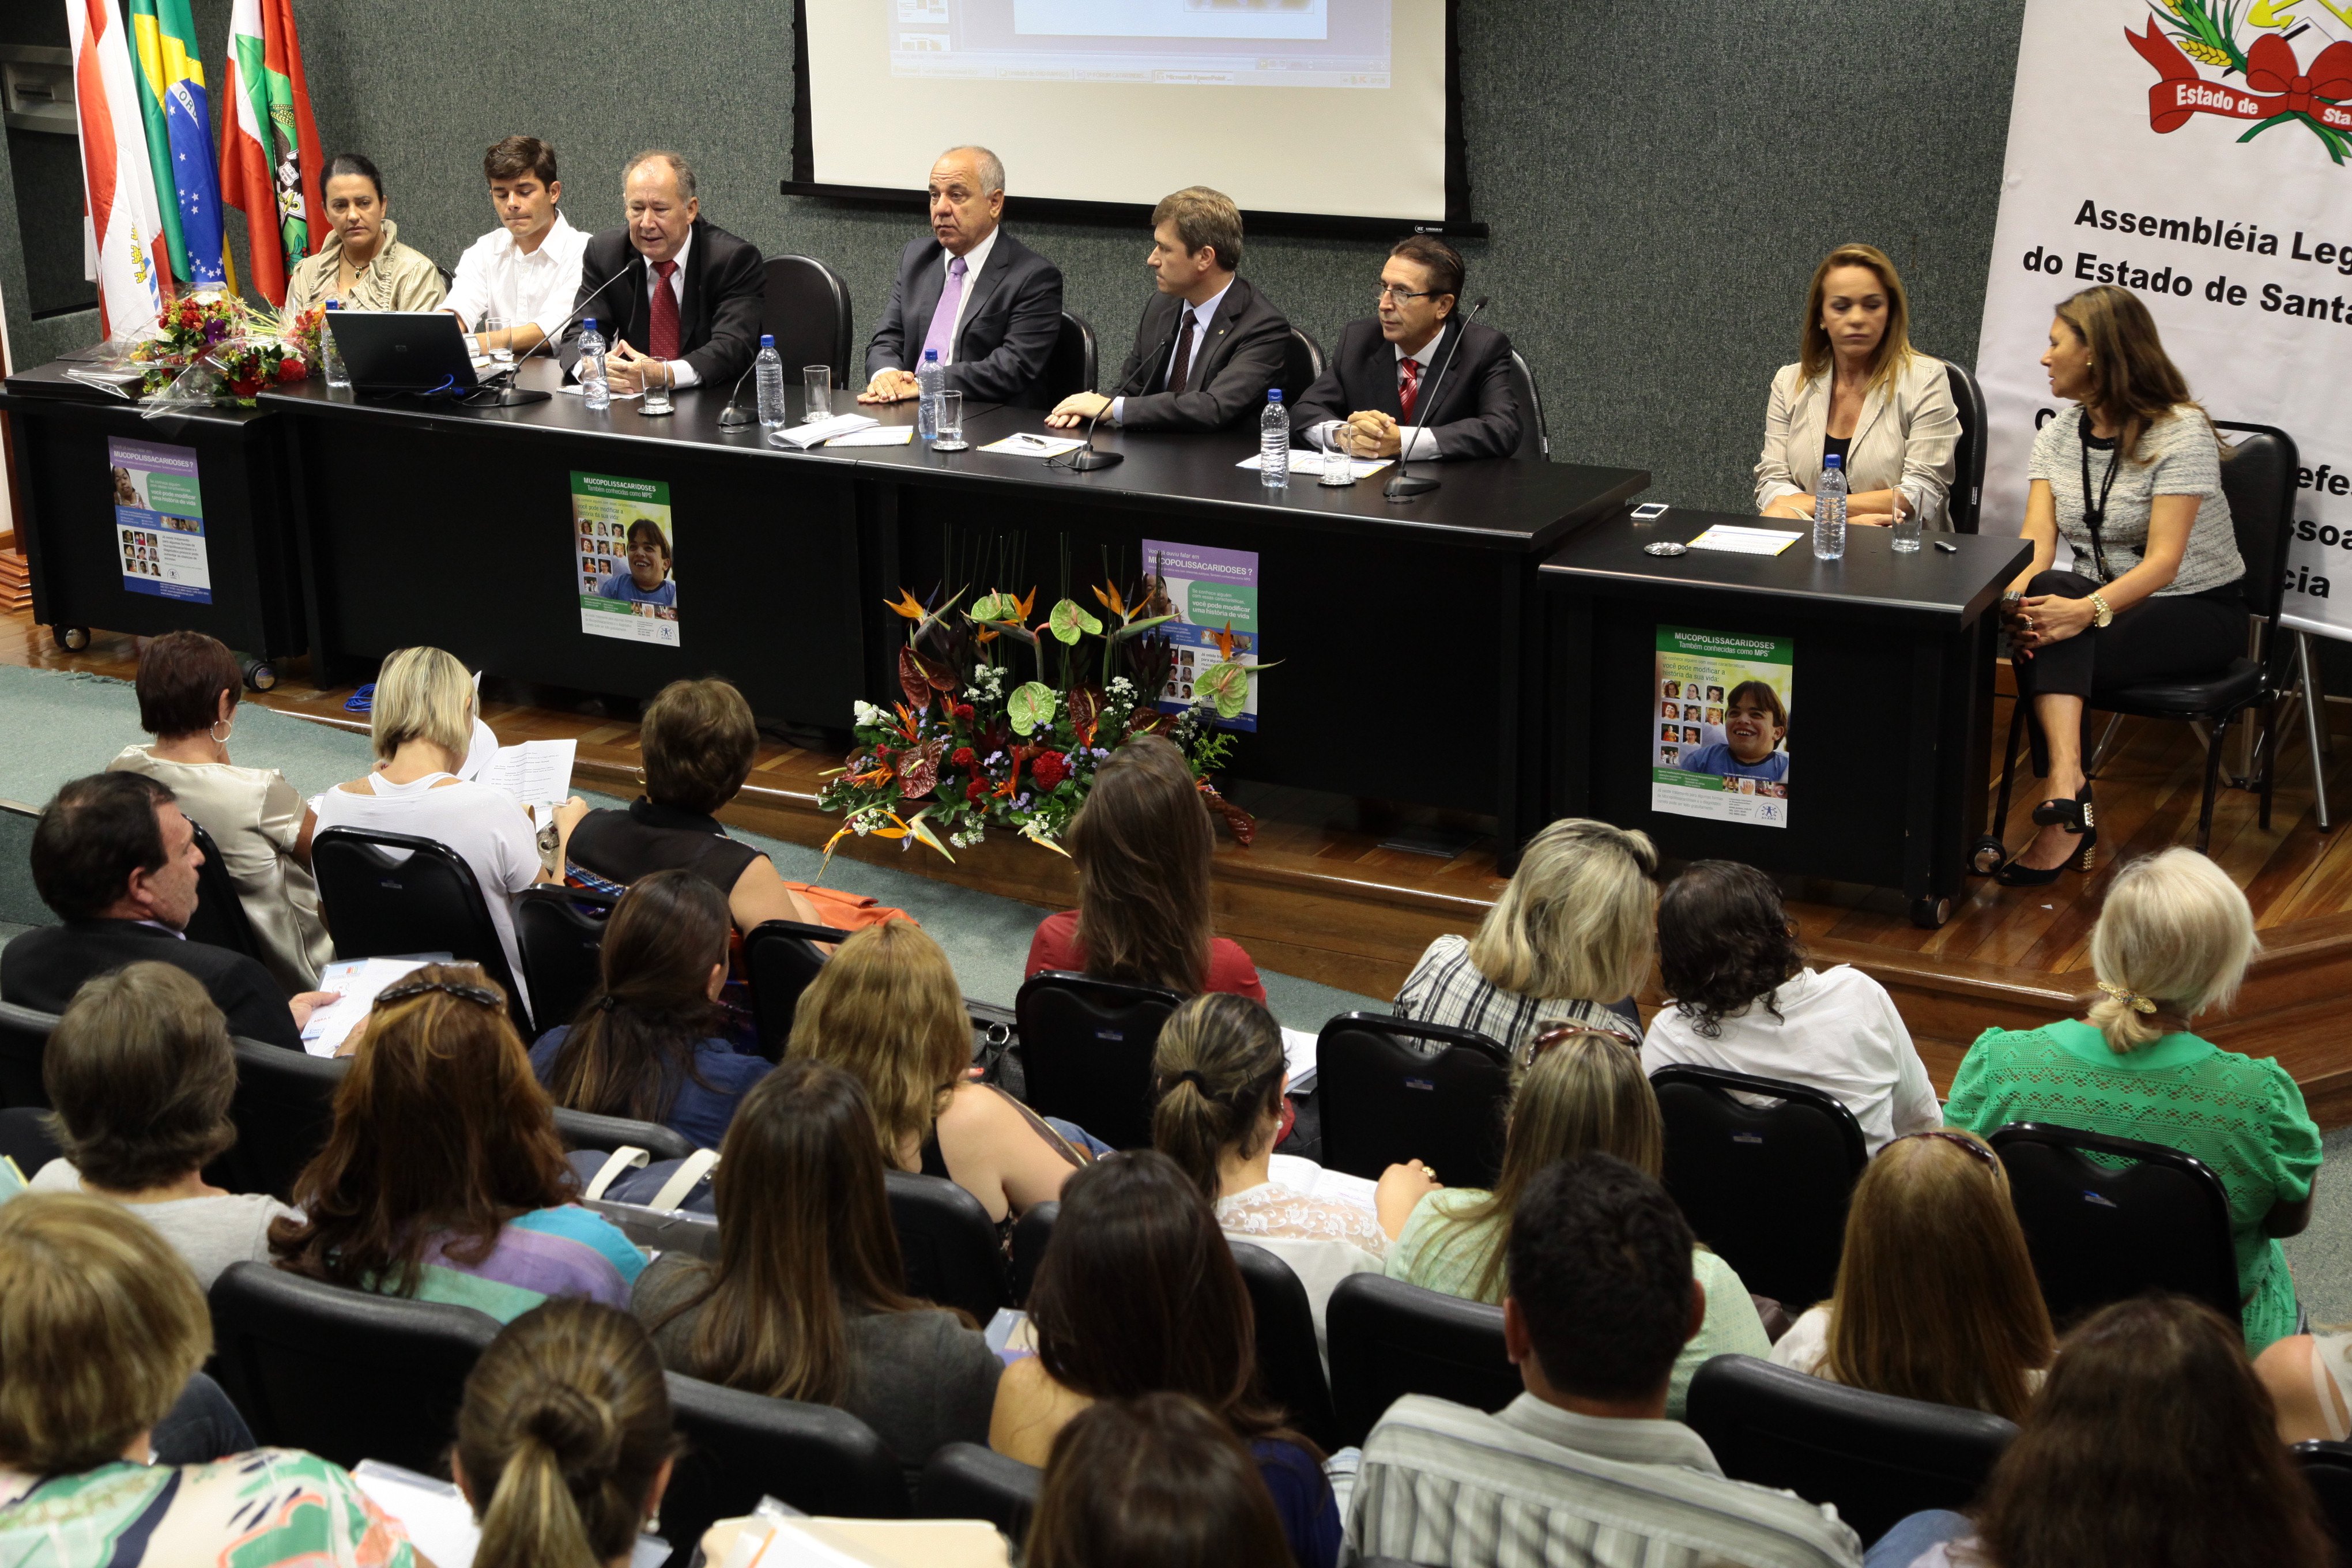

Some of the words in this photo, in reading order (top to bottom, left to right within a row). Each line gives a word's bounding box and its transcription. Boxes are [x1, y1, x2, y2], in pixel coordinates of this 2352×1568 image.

[2177, 84, 2233, 110] Estado
[2238, 98, 2258, 114] de
[2322, 108, 2352, 125] Sta
[2074, 199, 2279, 256] Assembléia
[2023, 246, 2063, 275] do
[2075, 252, 2193, 297] Estado
[2205, 276, 2247, 306] de
[114, 451, 189, 468] MUCOPOLISSACARIDOSES
[583, 477, 656, 492] MUCOPOLISSACARIDOSES
[606, 488, 628, 496] conhecidas
[1247, 568, 1253, 576] ?
[1206, 608, 1228, 617] história
[1223, 605, 1250, 613] modificar
[1675, 632, 1775, 650] MUCOPOLISSACARIDOSES
[1679, 641, 1702, 650] Também
[1703, 644, 1736, 654] conhecidas
[1663, 670, 1684, 678] história
[1693, 666, 1720, 674] modificar
